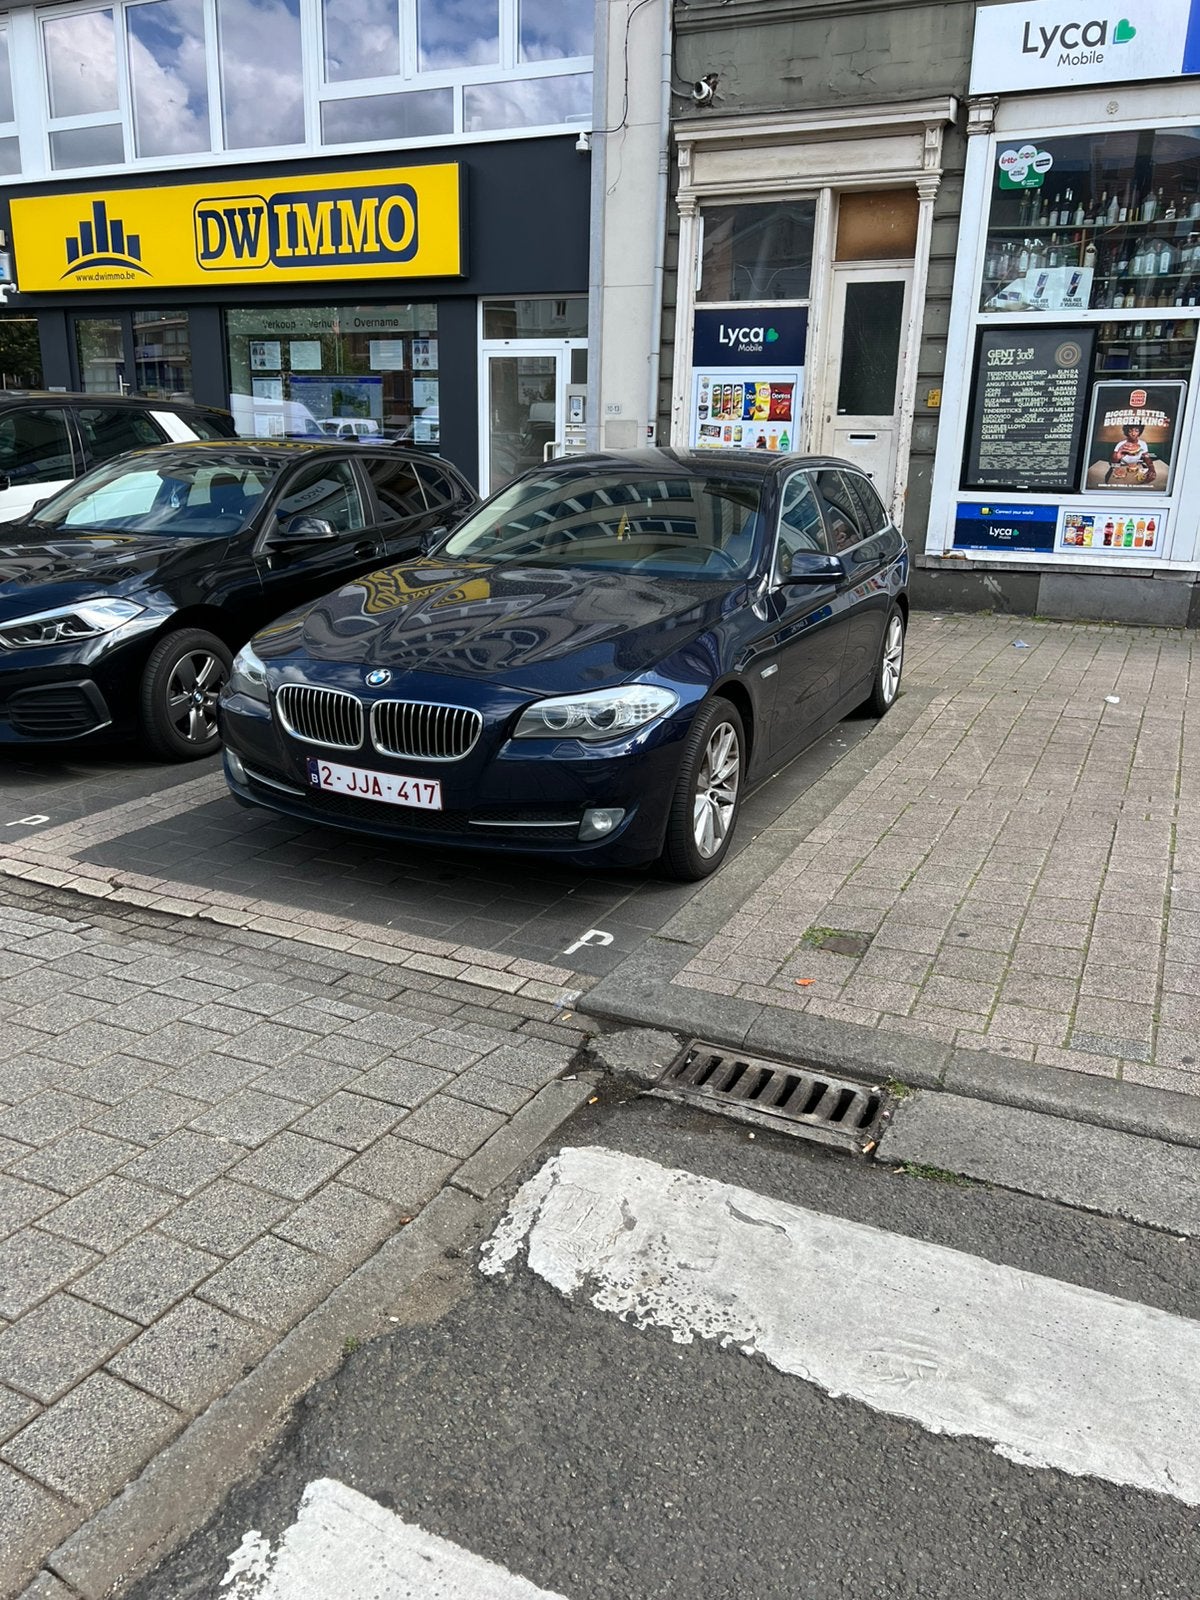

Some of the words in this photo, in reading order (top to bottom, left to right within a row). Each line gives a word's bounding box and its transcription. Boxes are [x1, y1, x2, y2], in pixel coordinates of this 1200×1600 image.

[1022, 20, 1108, 58] Lyca
[1057, 50, 1104, 67] Mobile
[197, 205, 265, 260] DW
[274, 194, 415, 258] IMMO
[76, 270, 135, 281] www.dwimmo.be
[262, 320, 296, 330] Verkoop
[307, 319, 341, 328] Verhuur
[354, 317, 399, 328] Overname
[719, 324, 764, 346] Lyca
[737, 344, 763, 352] Mobile
[987, 349, 1015, 358] GENT
[987, 357, 1014, 366] JAZZ
[1103, 417, 1140, 426] BURGER
[989, 526, 1012, 537] Lyca
[311, 774, 319, 783] B
[321, 765, 436, 805] 2-JJA-417
